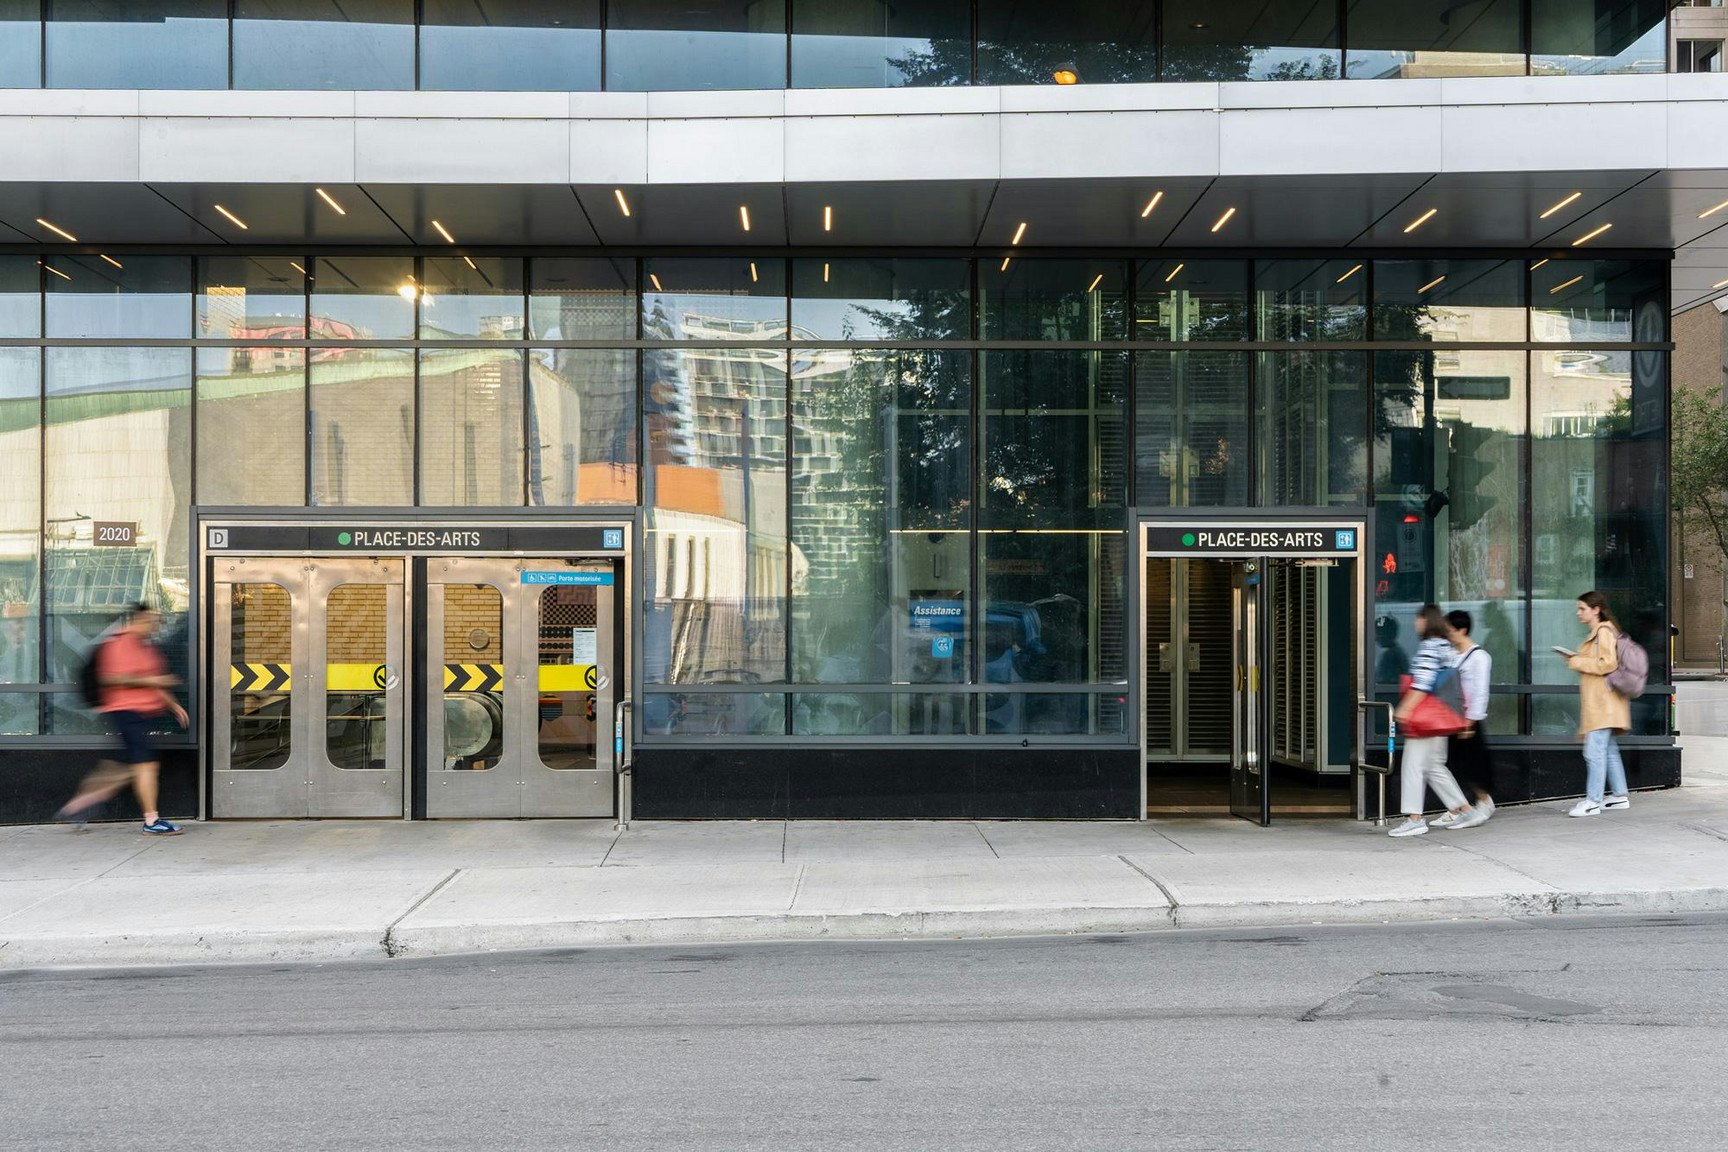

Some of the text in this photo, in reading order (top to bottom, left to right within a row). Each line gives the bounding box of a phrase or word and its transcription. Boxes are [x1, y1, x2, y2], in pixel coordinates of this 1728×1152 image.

[99, 527, 131, 541] 2020
[214, 532, 224, 545] D
[354, 531, 481, 546] PLACE-DES-ARTS
[1198, 532, 1323, 547] PLACE-DES-ARTS
[913, 605, 961, 616] Assistance
